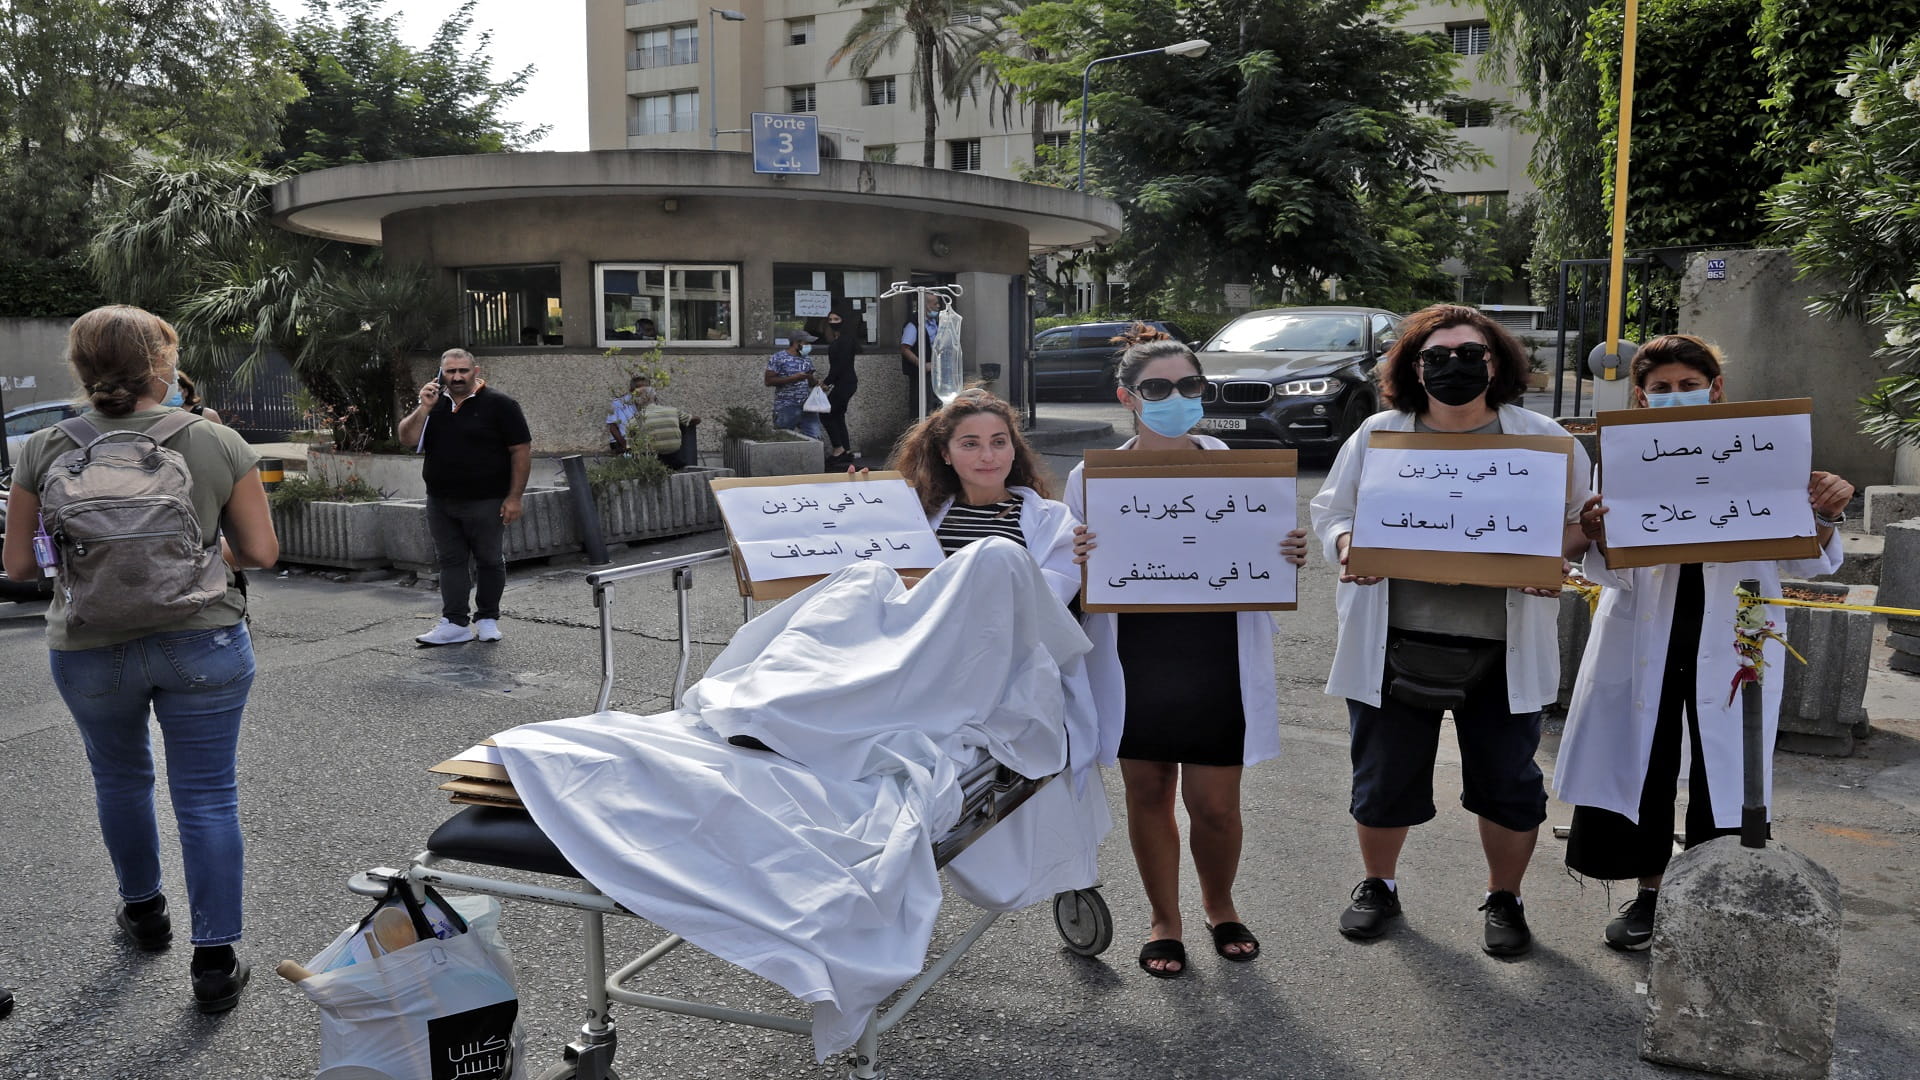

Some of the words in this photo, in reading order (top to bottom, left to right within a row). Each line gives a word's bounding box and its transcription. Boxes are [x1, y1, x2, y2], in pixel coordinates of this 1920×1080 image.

[764, 116, 806, 130] Porte
[778, 132, 794, 154] 3
[773, 156, 801, 171] باب
[1641, 438, 1703, 462] مصل
[1711, 434, 1743, 464] في
[1751, 433, 1775, 452] ما
[1398, 463, 1459, 480] بنزين
[1466, 461, 1498, 483] في
[1507, 461, 1529, 476] ما
[762, 496, 819, 515] بنزين
[828, 493, 856, 514] في
[858, 492, 884, 505] ما
[1119, 494, 1196, 521] كهرباء
[1244, 494, 1267, 513] ما
[1746, 499, 1771, 517] ما
[1204, 494, 1236, 524] في
[1641, 503, 1697, 533] علاج
[1709, 500, 1739, 529] في
[1381, 511, 1455, 530] اسعاف
[1464, 514, 1496, 541] في
[1506, 515, 1528, 533] ما
[770, 540, 844, 559] اسعاف
[854, 538, 883, 561] في
[885, 537, 911, 551] ما
[1108, 562, 1199, 588] مستشفى
[1208, 561, 1239, 591] في
[1248, 561, 1270, 580] ما
